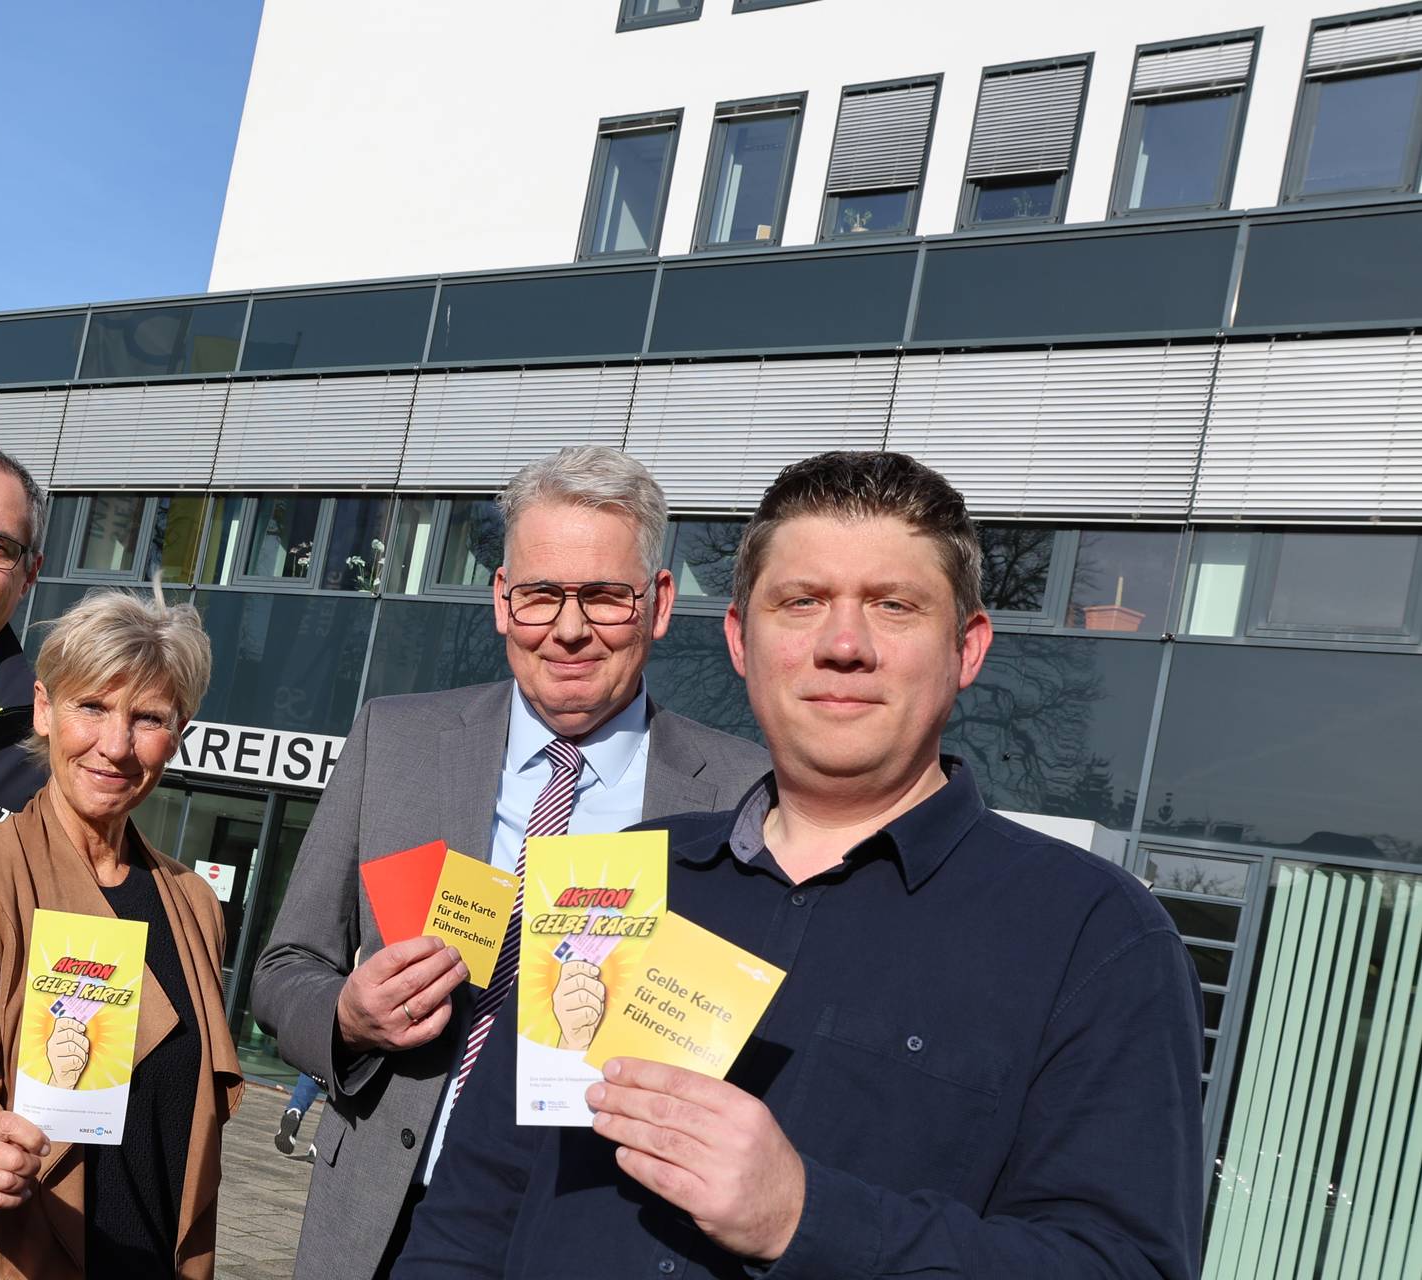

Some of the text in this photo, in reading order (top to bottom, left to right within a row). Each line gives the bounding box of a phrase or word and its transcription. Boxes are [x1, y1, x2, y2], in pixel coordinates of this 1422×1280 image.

[441, 889, 497, 919] Gelbe Karte
[554, 887, 635, 909] AKTION
[436, 904, 471, 926] für den
[530, 914, 658, 938] GELBE KARTE
[432, 918, 496, 950] Führerschein!
[53, 956, 116, 981] AKTION
[33, 975, 133, 1006] GELBE KARTE
[634, 984, 687, 1022] für den
[645, 966, 733, 1024] Gelbe Karte
[623, 1004, 725, 1067] Führerschein!
